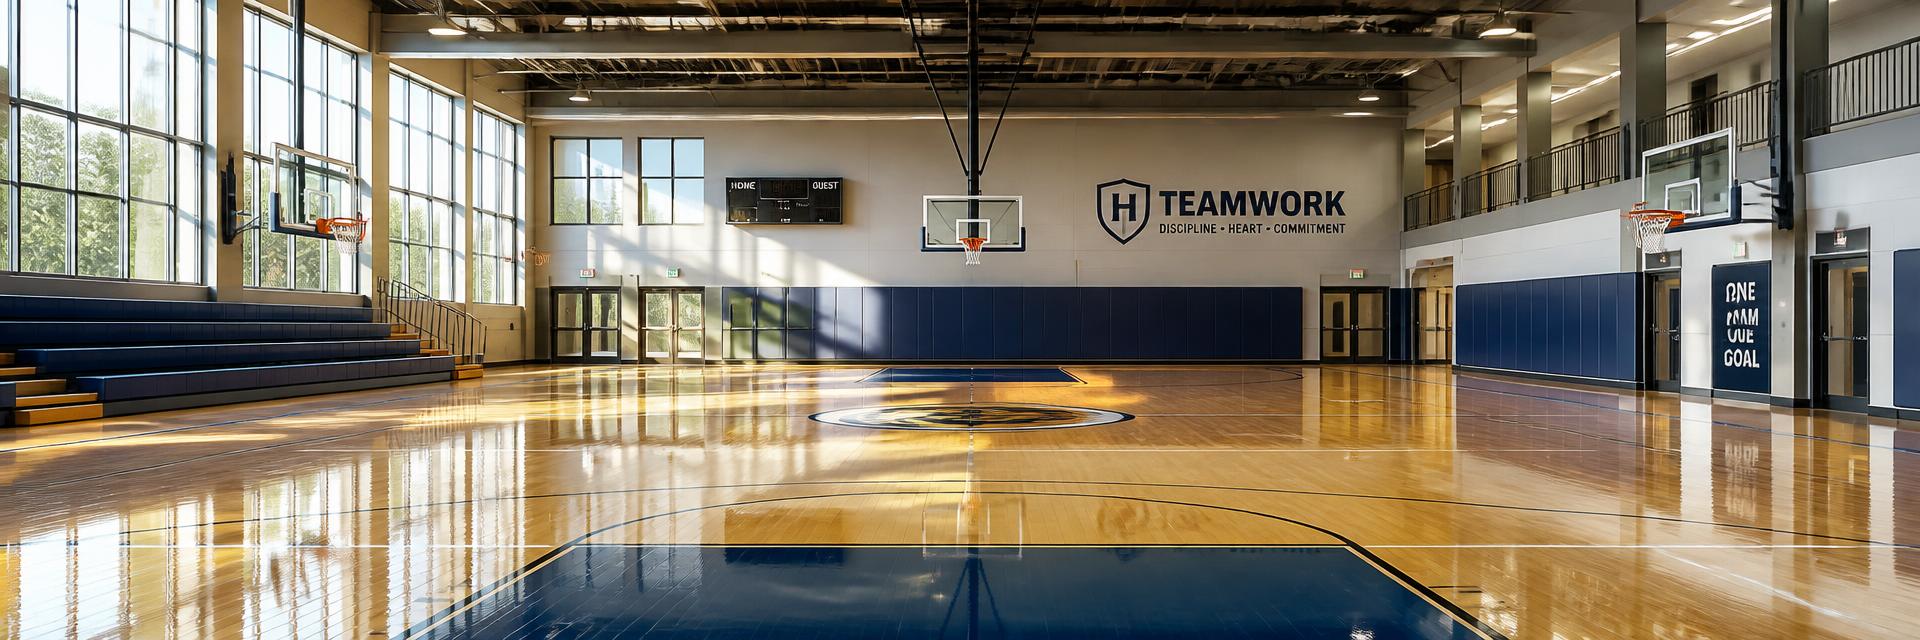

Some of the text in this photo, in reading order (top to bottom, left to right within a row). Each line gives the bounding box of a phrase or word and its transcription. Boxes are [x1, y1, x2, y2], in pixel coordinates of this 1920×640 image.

[1112, 193, 1136, 221] H
[1159, 191, 1346, 216] TEAMWORK
[1160, 223, 1346, 234] DISCIPLINE HEART COMMITMENT
[1724, 349, 1760, 368] GOAL
